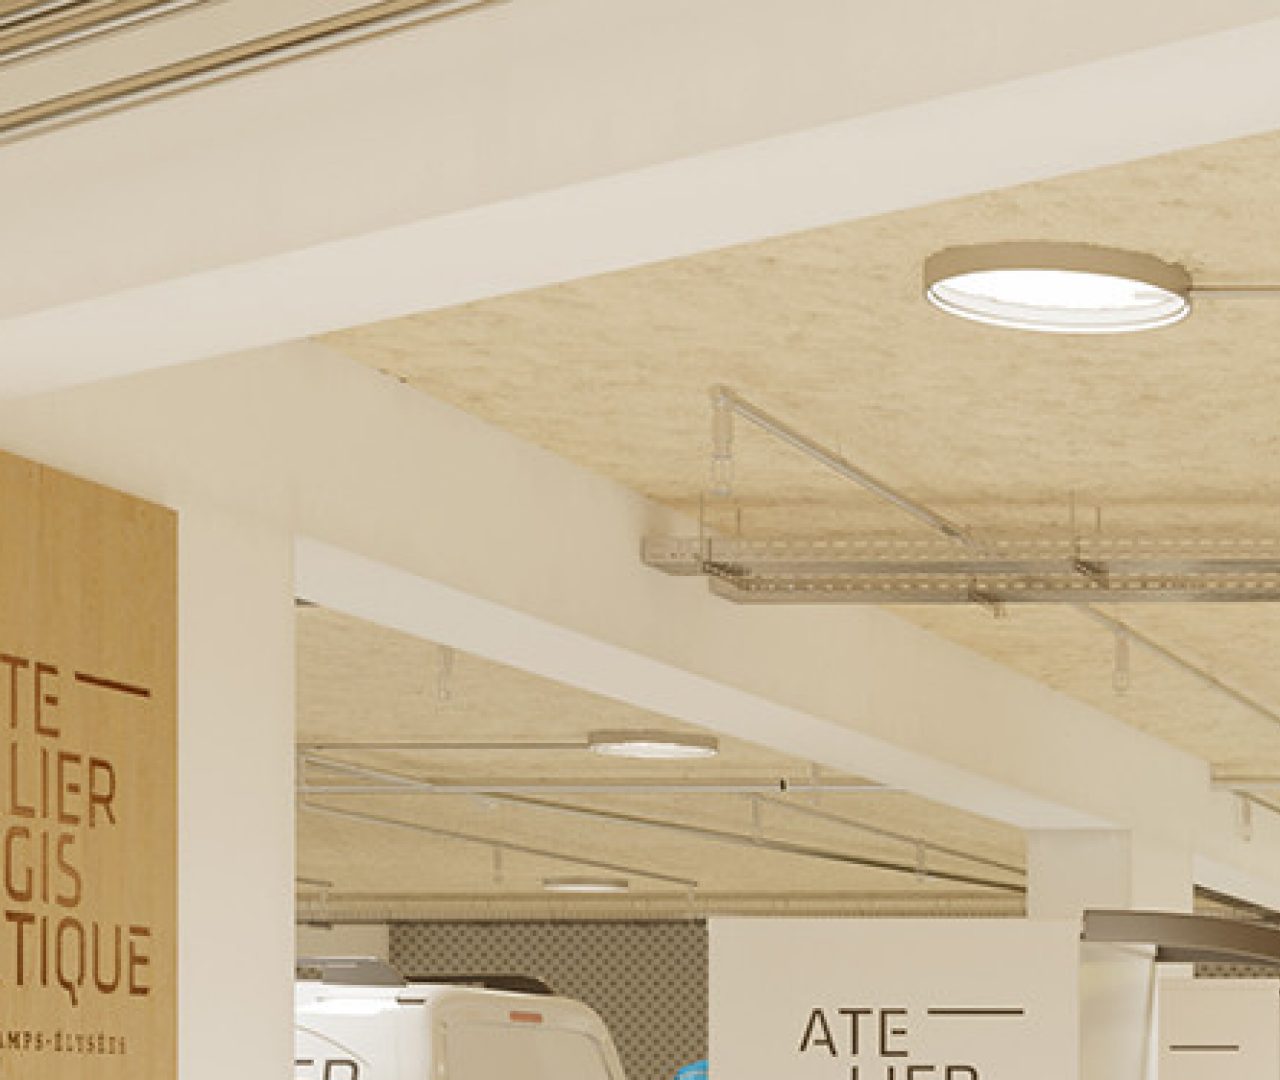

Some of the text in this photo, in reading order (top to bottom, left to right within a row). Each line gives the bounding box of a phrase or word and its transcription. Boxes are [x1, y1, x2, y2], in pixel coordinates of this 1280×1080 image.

[11, 743, 116, 828] LIER
[4, 826, 82, 907] GIS
[5, 911, 152, 1008] TIQUE
[800, 1007, 909, 1058] ATE
